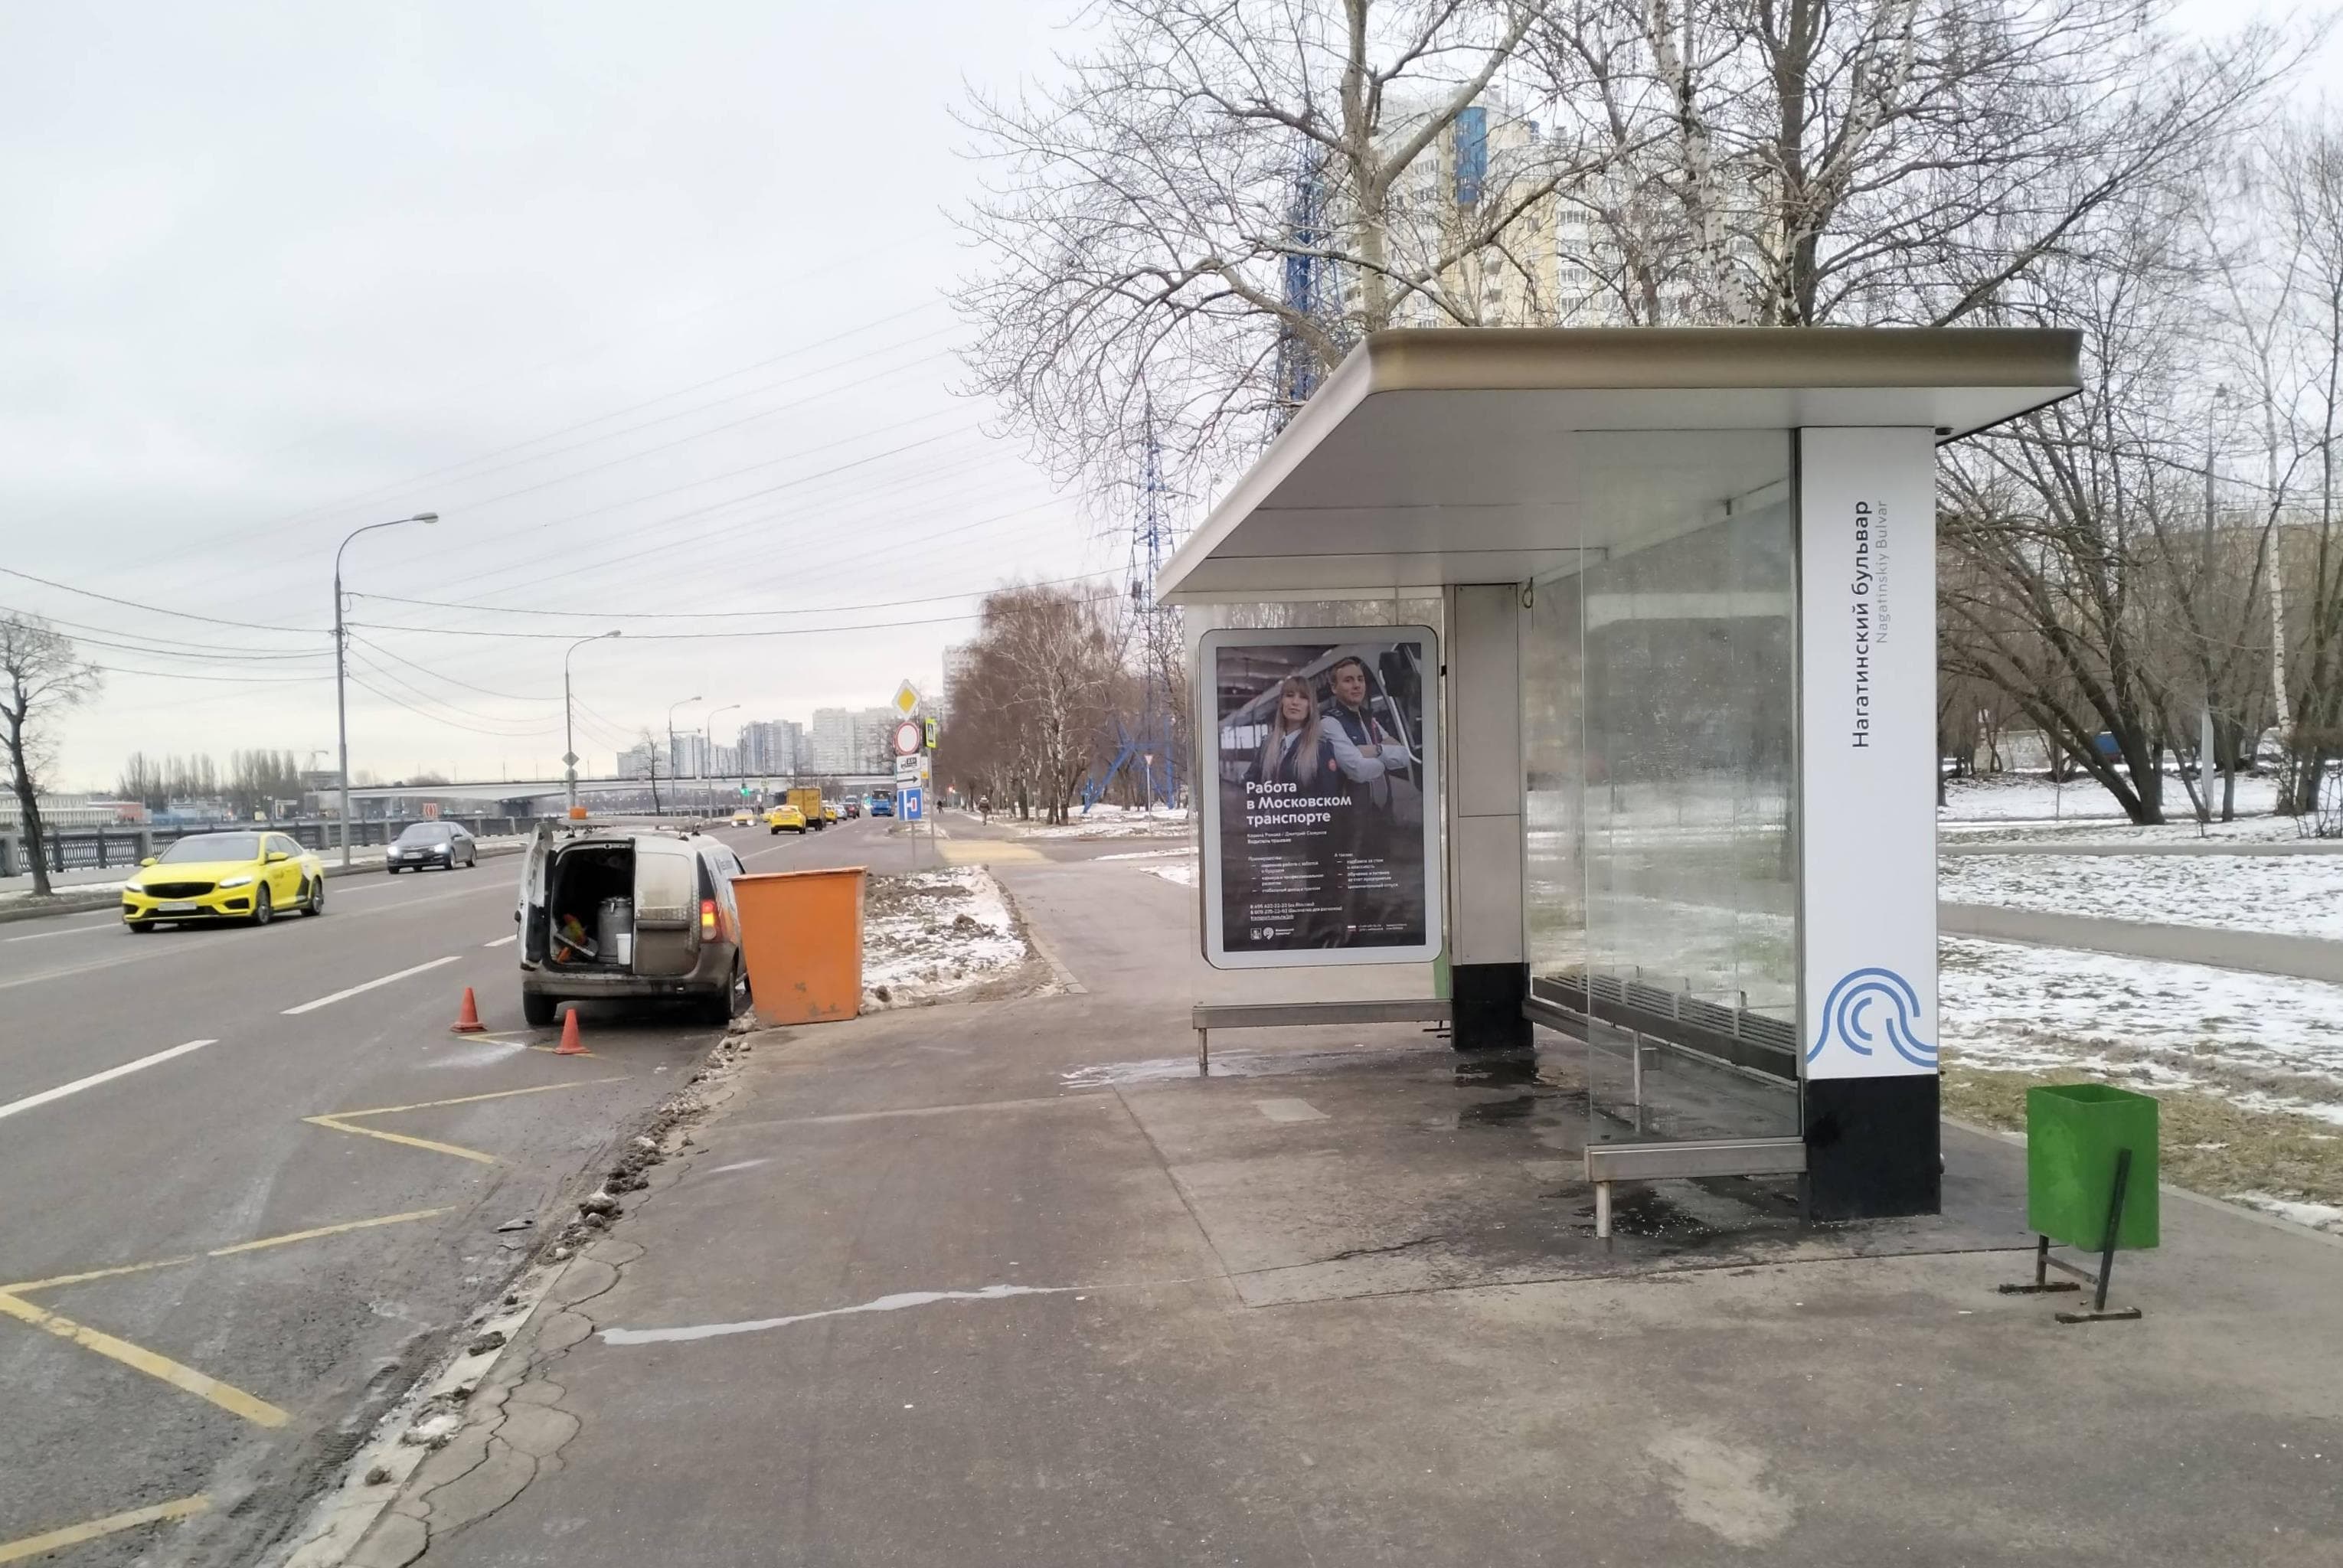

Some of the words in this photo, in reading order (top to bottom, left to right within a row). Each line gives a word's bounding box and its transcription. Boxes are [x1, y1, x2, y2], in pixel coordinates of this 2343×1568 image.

[1851, 500, 1873, 596] бульвар
[1875, 500, 1888, 549] Bulvar
[1875, 553, 1891, 644] Nagatinskiy
[1851, 603, 1869, 748] Нагатинский
[1246, 780, 1297, 794] Работа
[1247, 800, 1255, 809] в
[1258, 796, 1352, 809] Московском
[1246, 812, 1332, 828] транспорте
